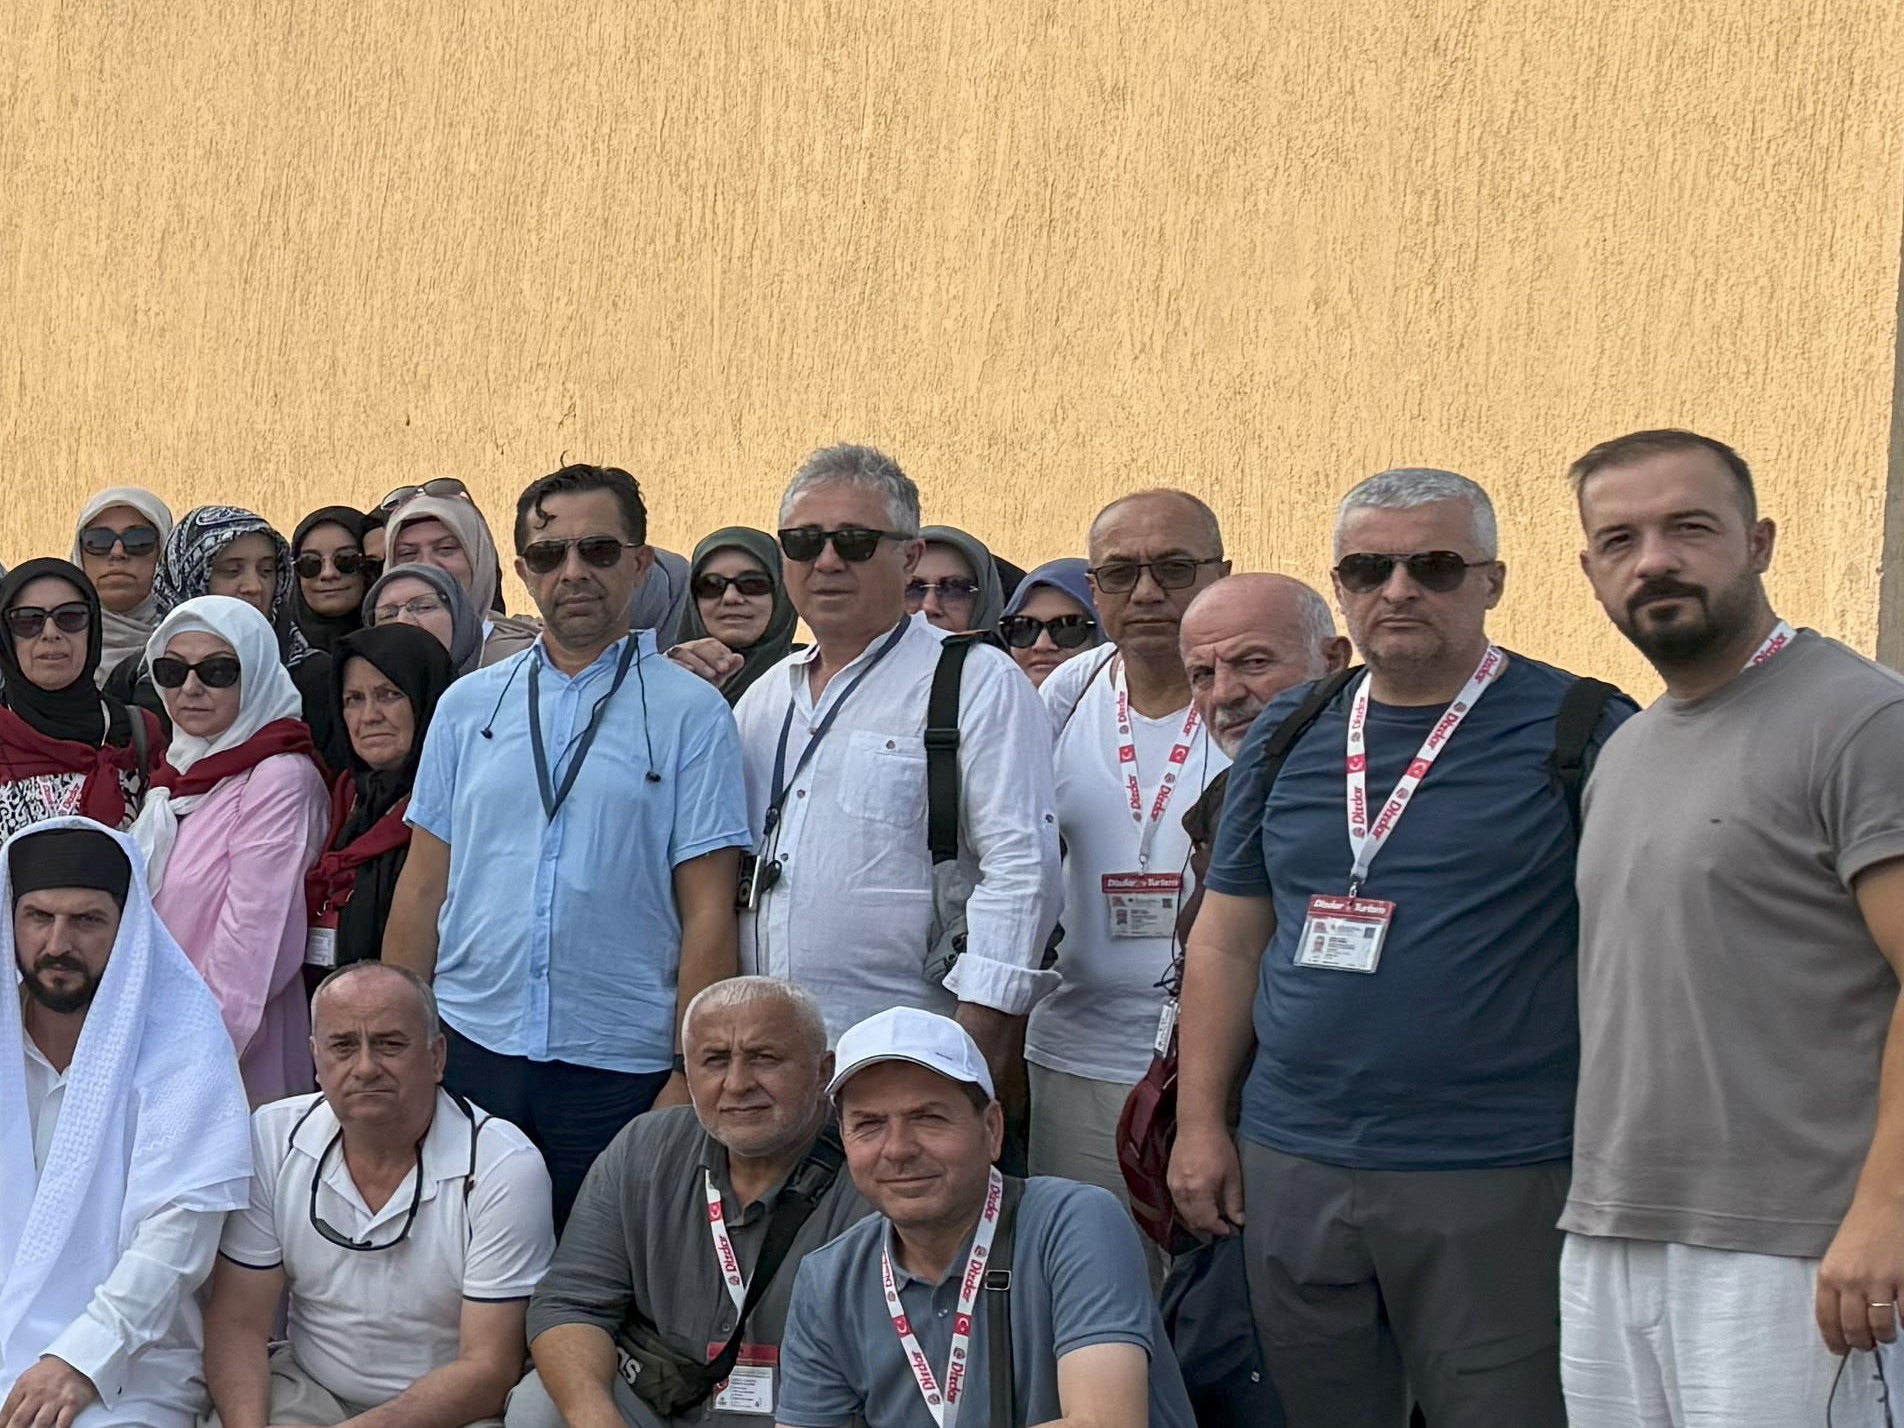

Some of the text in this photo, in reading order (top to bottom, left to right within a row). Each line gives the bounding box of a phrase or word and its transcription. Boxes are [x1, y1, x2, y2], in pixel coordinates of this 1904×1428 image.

[1426, 710, 1460, 751] Dizdar
[1126, 773, 1142, 810] Dizdar
[1149, 784, 1171, 822] Dizdar
[1352, 785, 1365, 824] Dizdar
[1371, 798, 1402, 842] Dizdar
[718, 1235, 737, 1273] Dizdar
[960, 1258, 983, 1303] Dizdar
[911, 1350, 937, 1390] Dizdar
[944, 1356, 967, 1405] Dizdar
